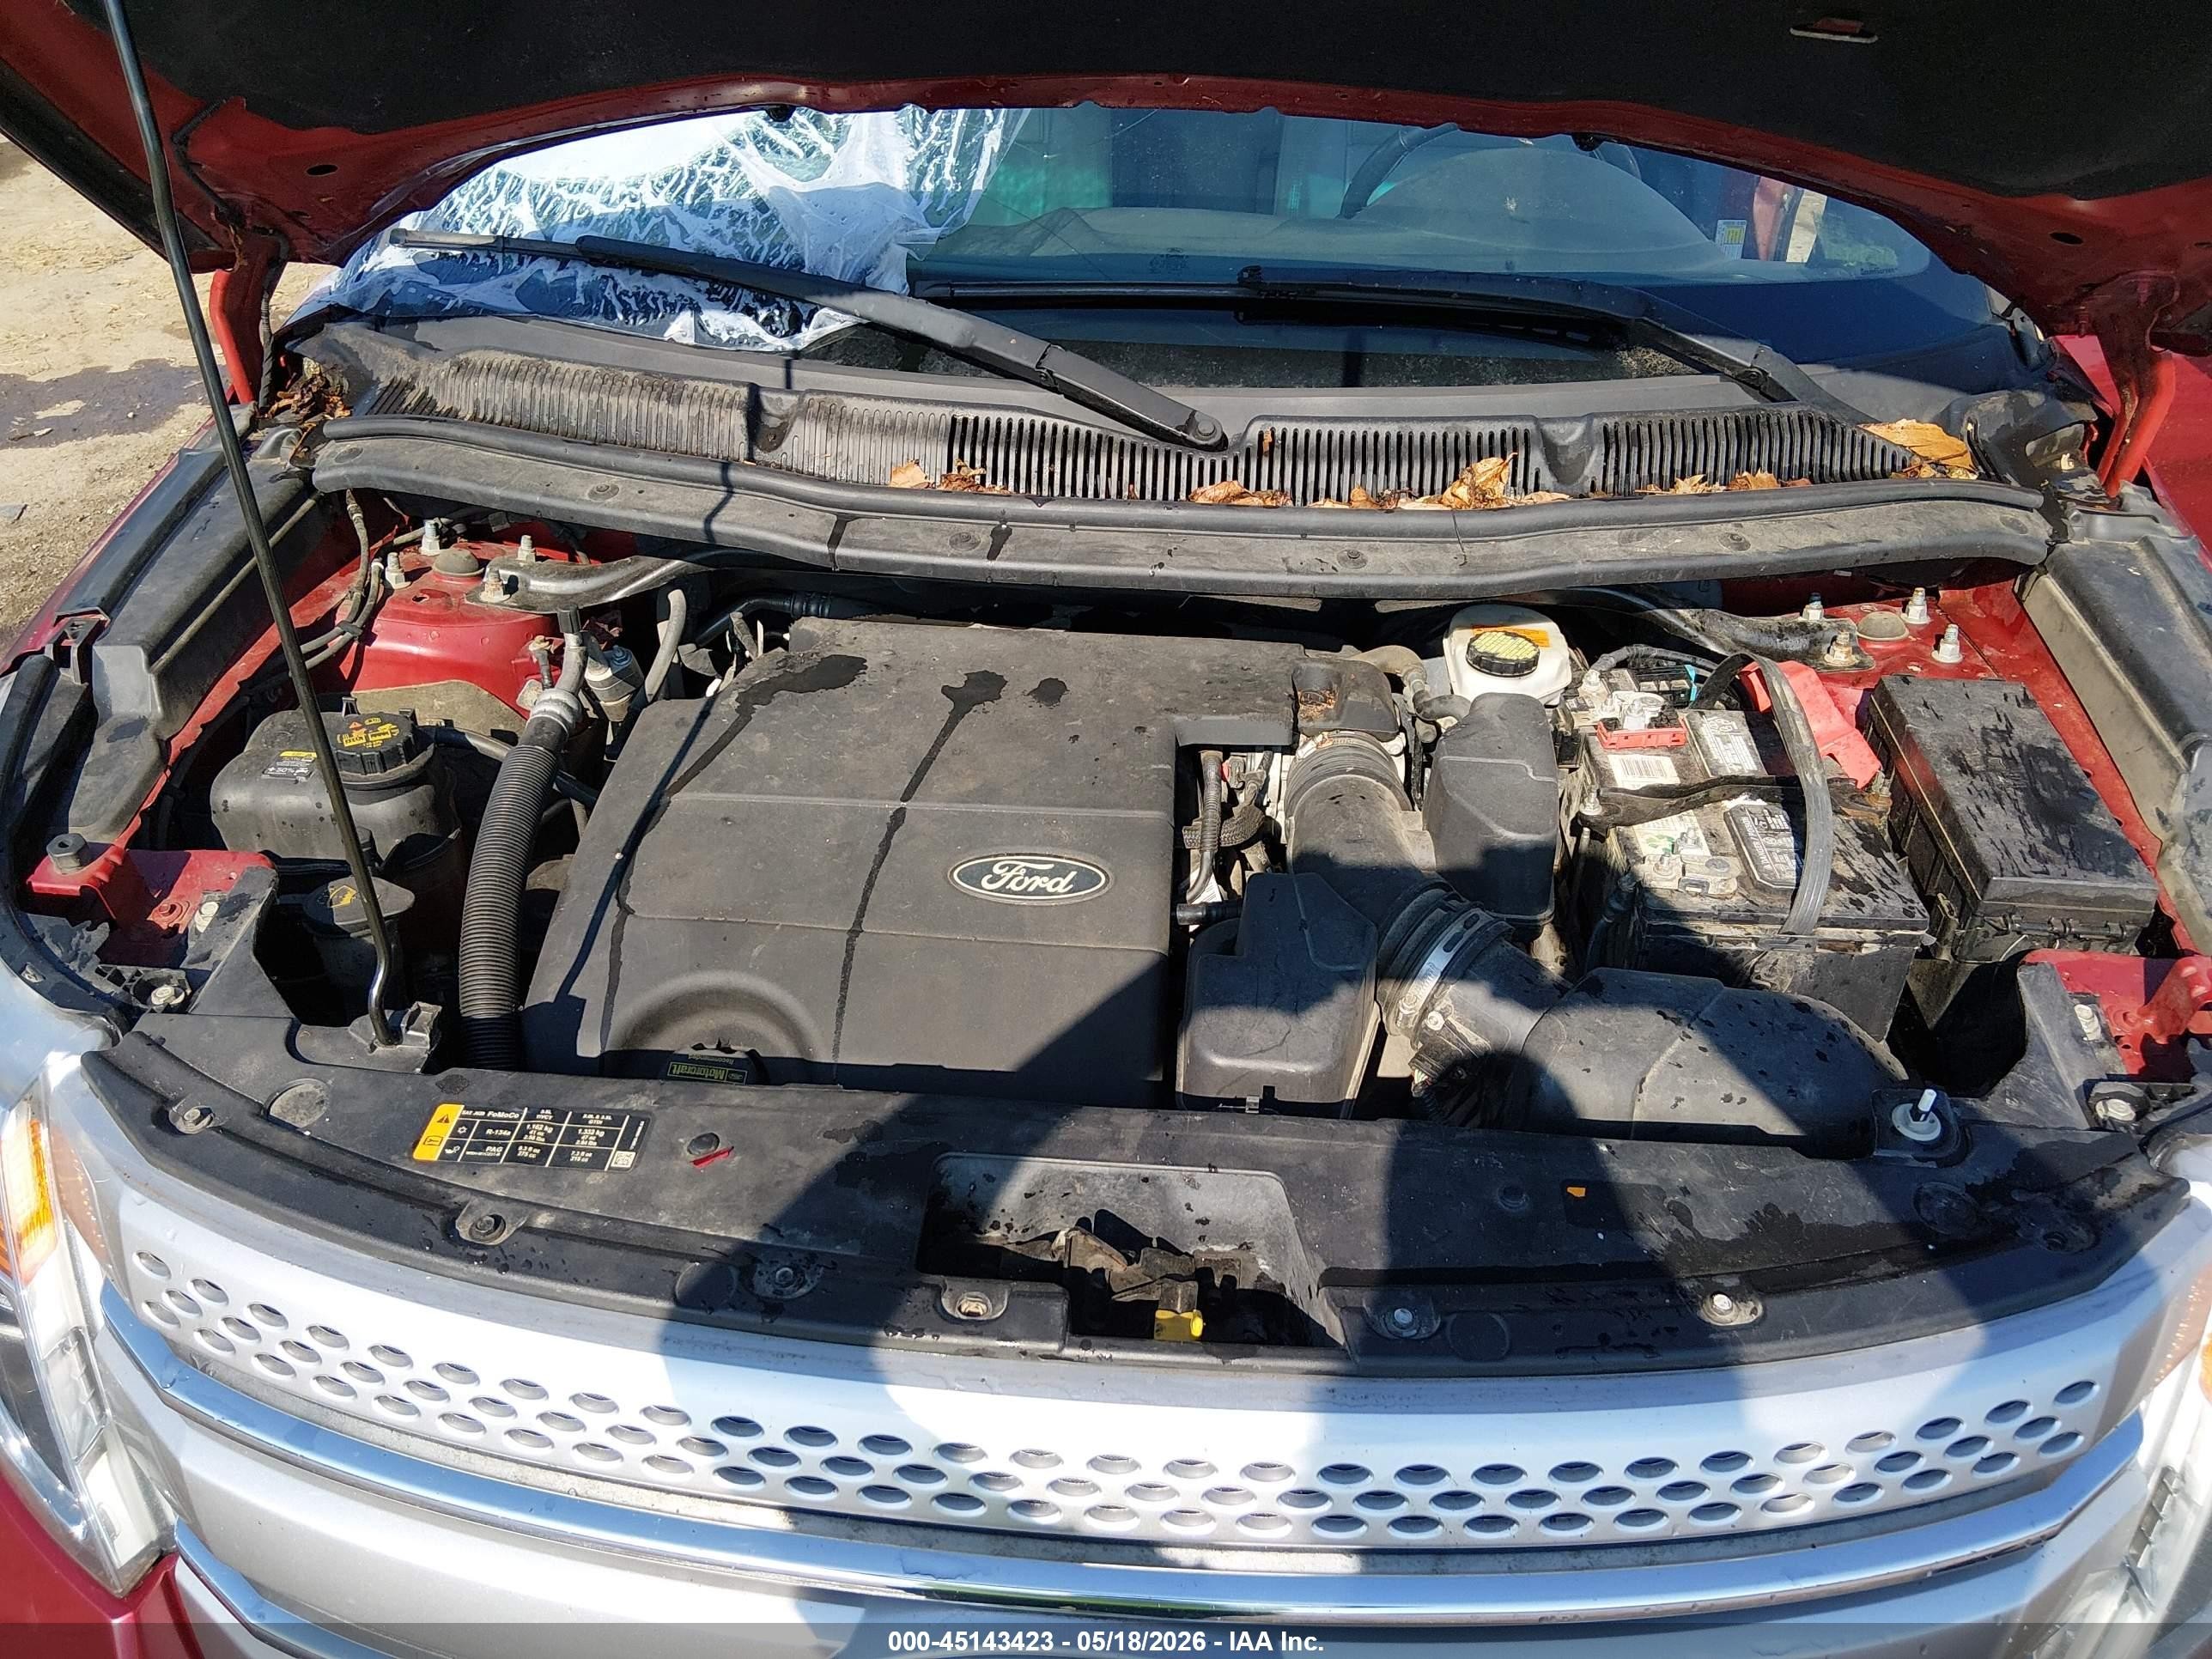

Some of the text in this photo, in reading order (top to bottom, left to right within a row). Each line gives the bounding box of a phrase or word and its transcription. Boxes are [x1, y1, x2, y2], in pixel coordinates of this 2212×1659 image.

[981, 860, 1078, 893] Ford
[672, 1064, 726, 1080] Motorcraft
[487, 1110, 520, 1119] FoMoCo
